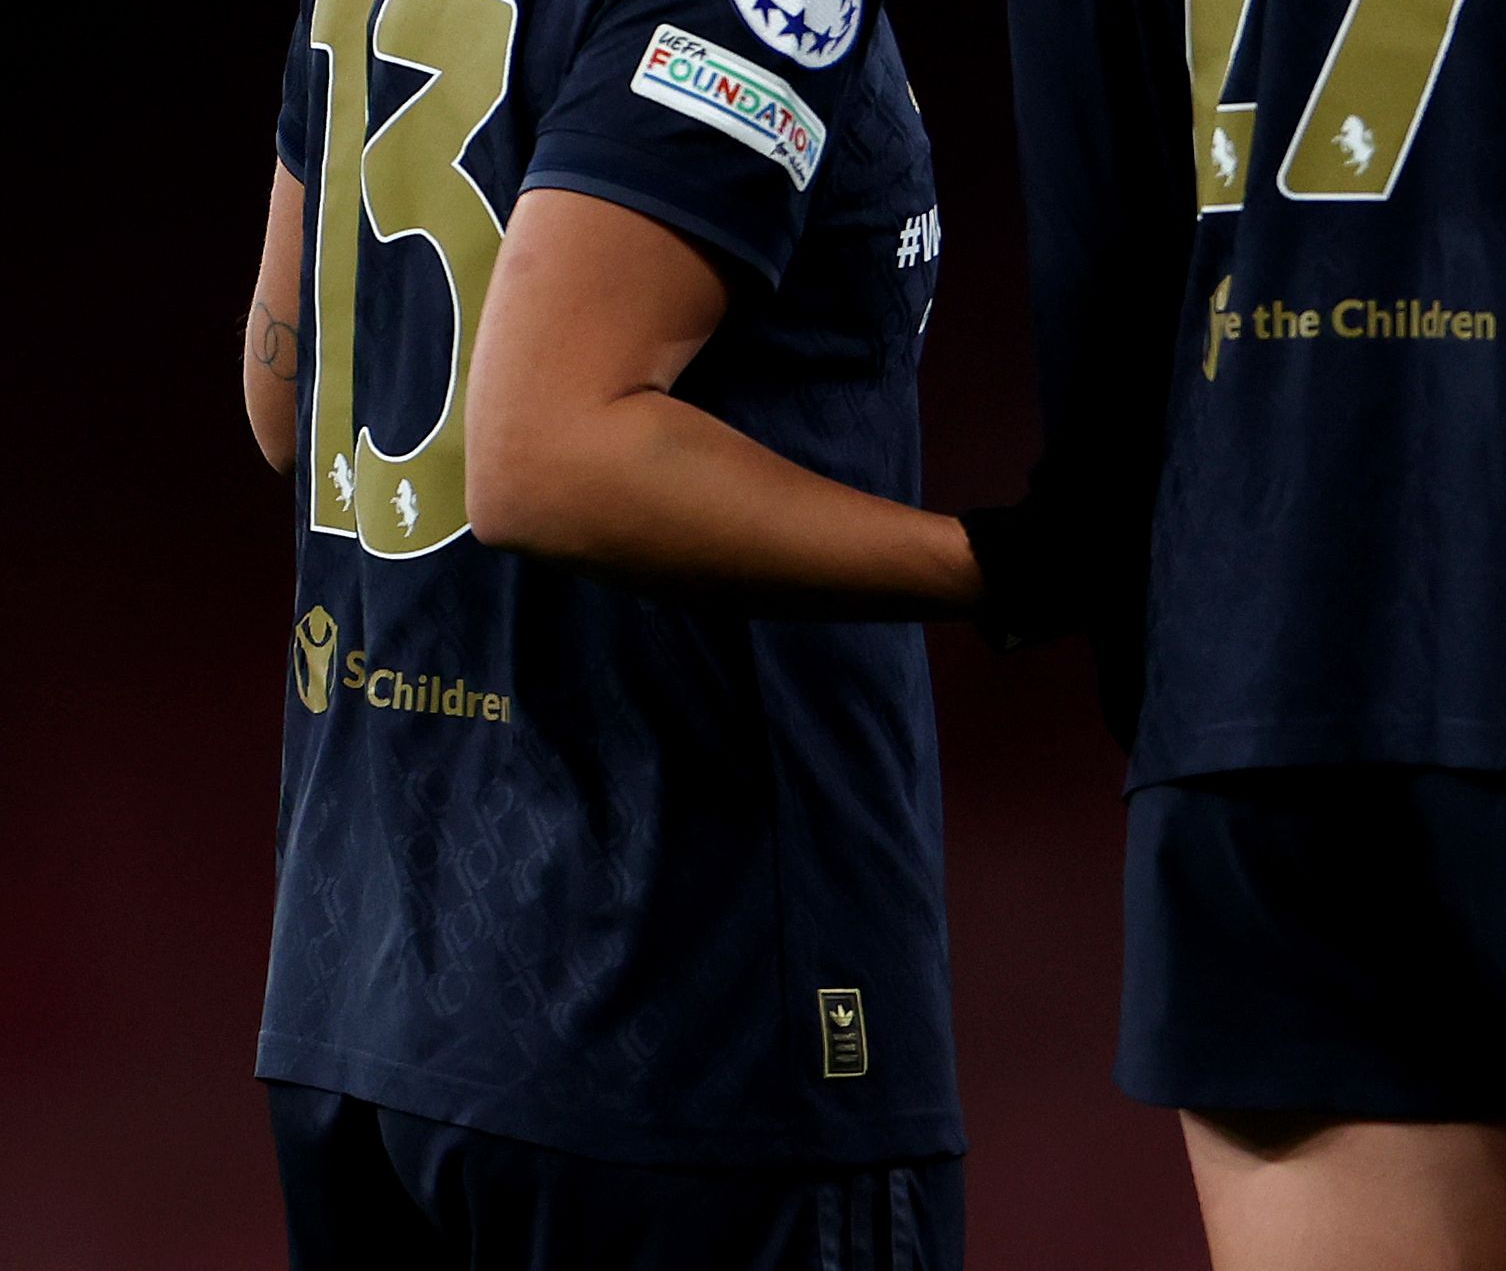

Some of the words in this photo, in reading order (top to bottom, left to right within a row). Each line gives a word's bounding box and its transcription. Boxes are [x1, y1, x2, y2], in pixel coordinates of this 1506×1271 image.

[657, 30, 708, 62] UEFA
[646, 47, 818, 168] FOUNDATION
[1253, 300, 1321, 340] the
[1331, 298, 1497, 340] Children
